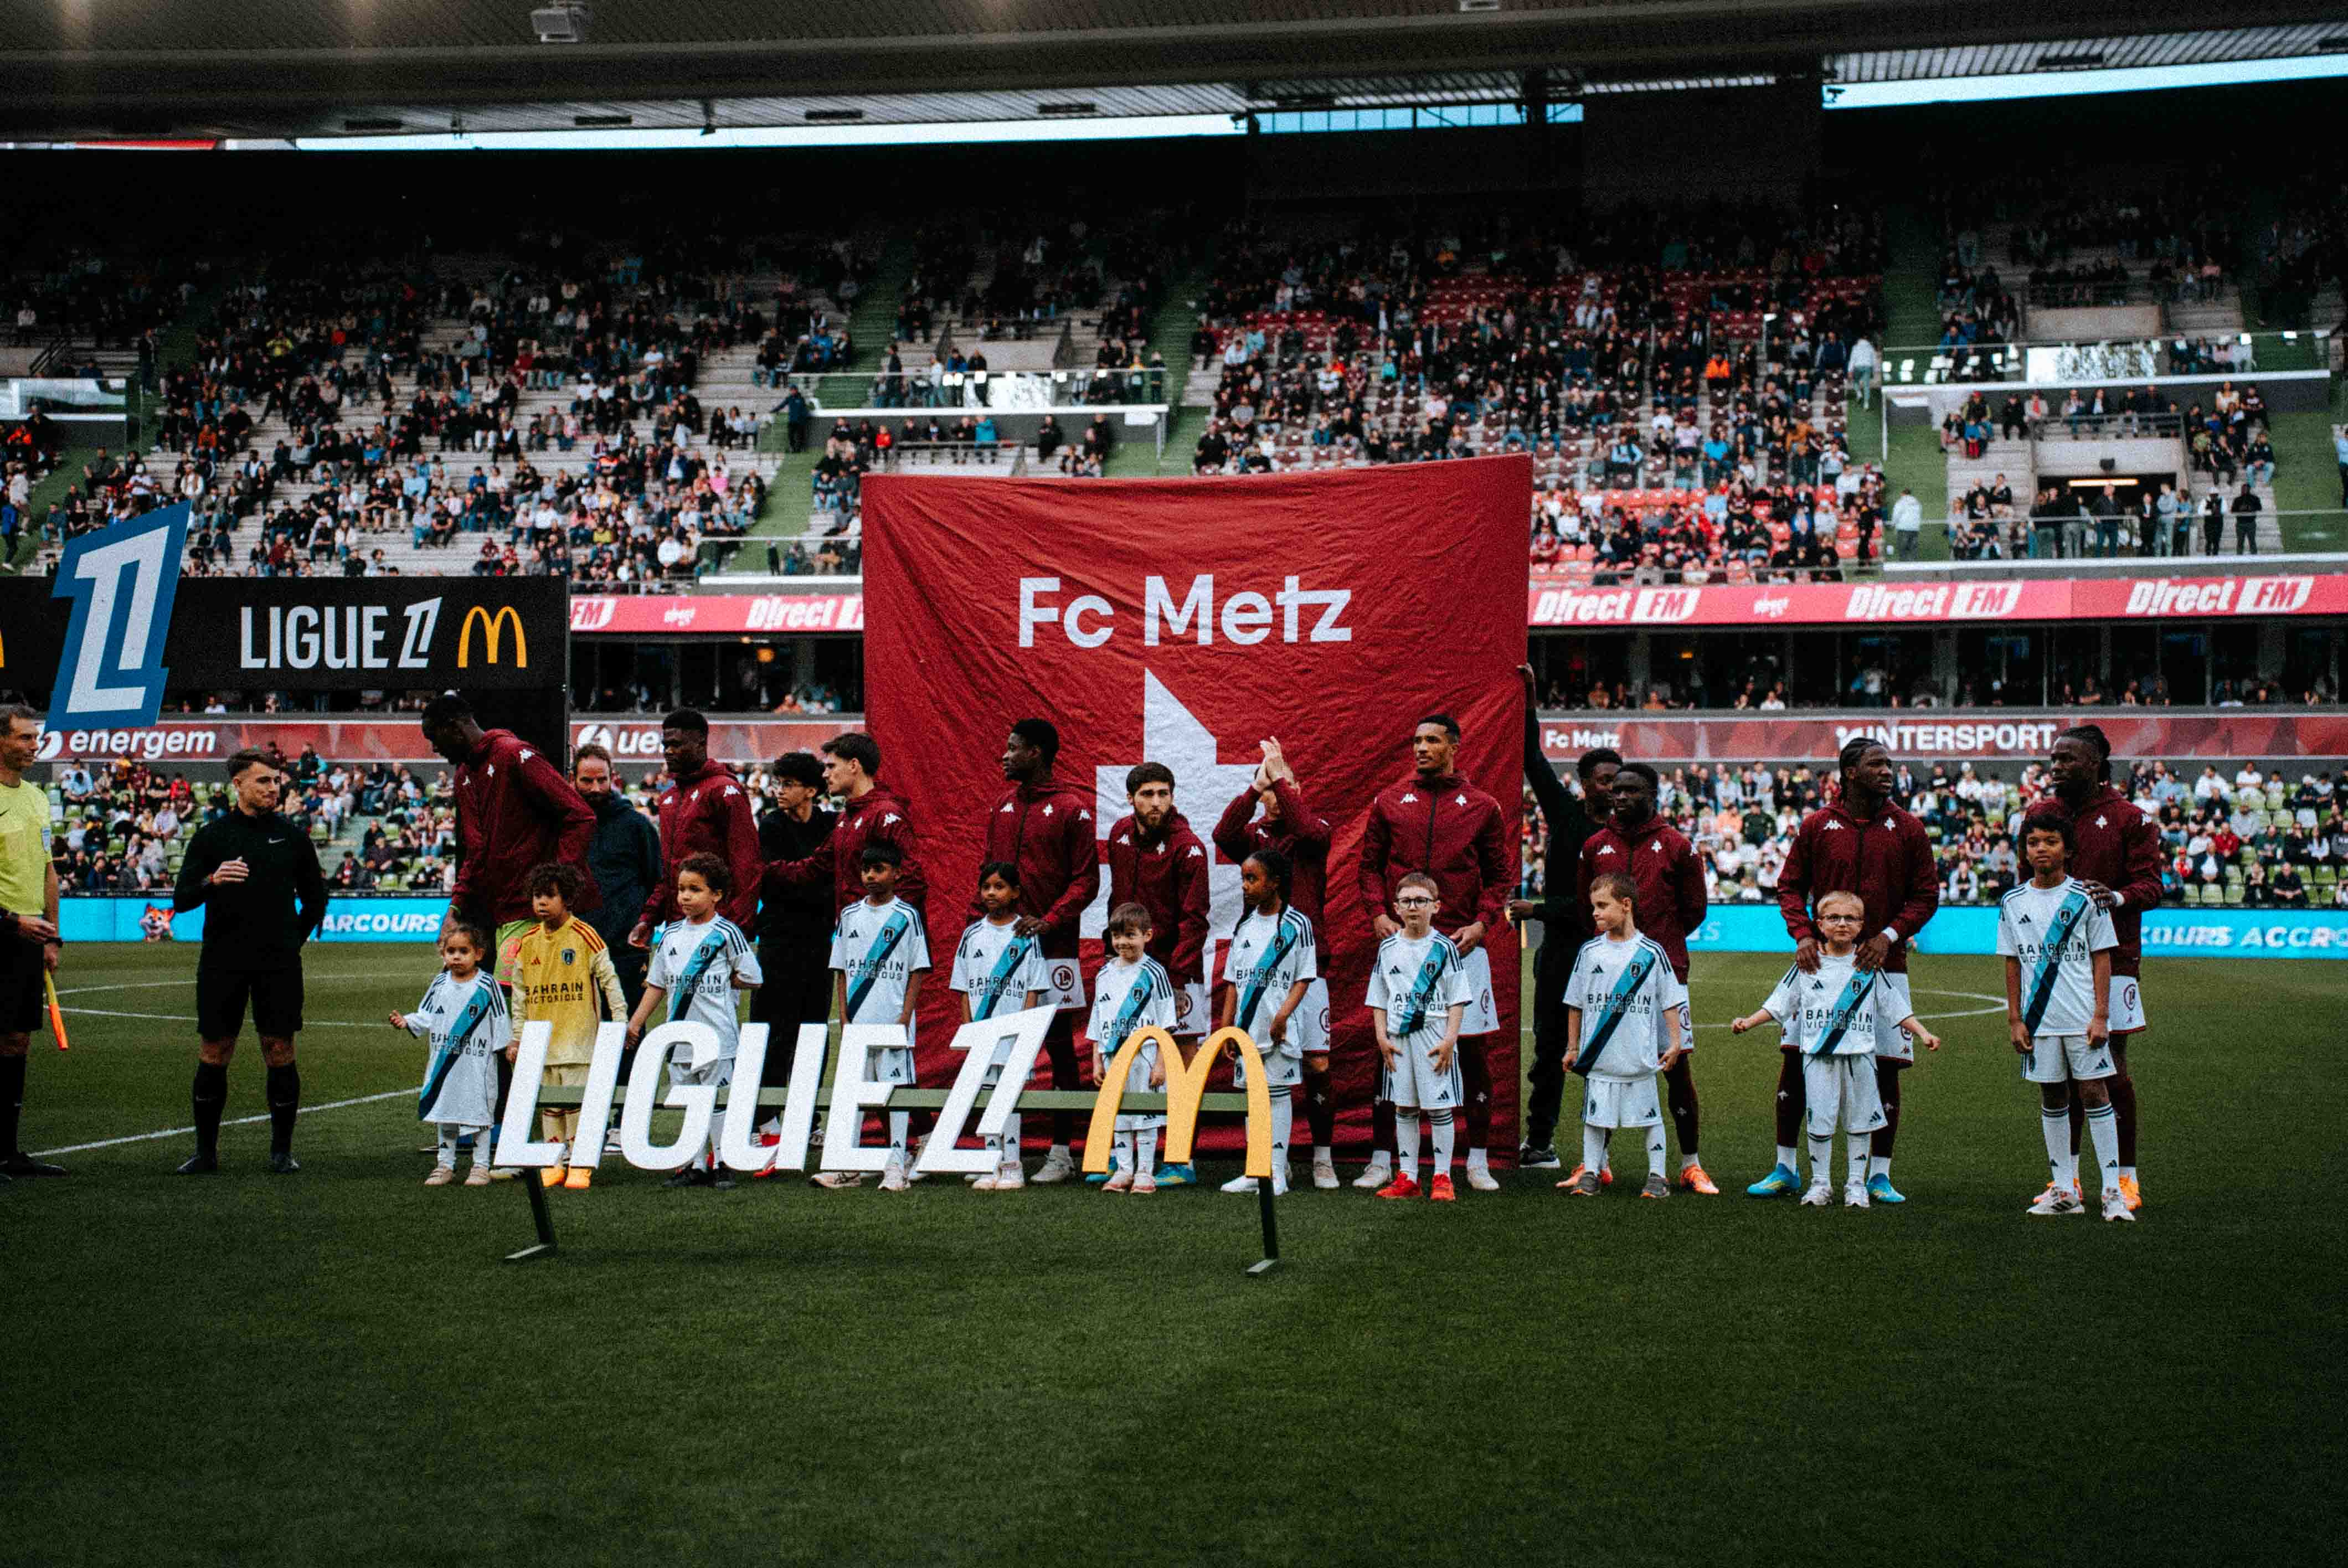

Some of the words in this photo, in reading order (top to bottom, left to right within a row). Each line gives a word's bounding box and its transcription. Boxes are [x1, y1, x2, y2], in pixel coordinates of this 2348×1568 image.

[1019, 577, 1114, 648] Fc
[1144, 574, 1352, 646] Metz
[240, 605, 390, 669] LIGUE
[70, 729, 217, 759] energem
[617, 730, 665, 755] ue
[1544, 729, 1569, 748] Fc
[1573, 729, 1620, 748] Metz
[322, 914, 441, 932] ARCOURS
[2017, 941, 2086, 955] BAHRAIN
[845, 960, 904, 972] AHRAIN
[525, 981, 584, 996] BAHRAIN
[969, 977, 1024, 990] BAHRAIN
[1587, 993, 1651, 1005] BAHRAIN
[1806, 1009, 1873, 1024] BAHRAIN
[494, 1020, 914, 1173] LIGUE
